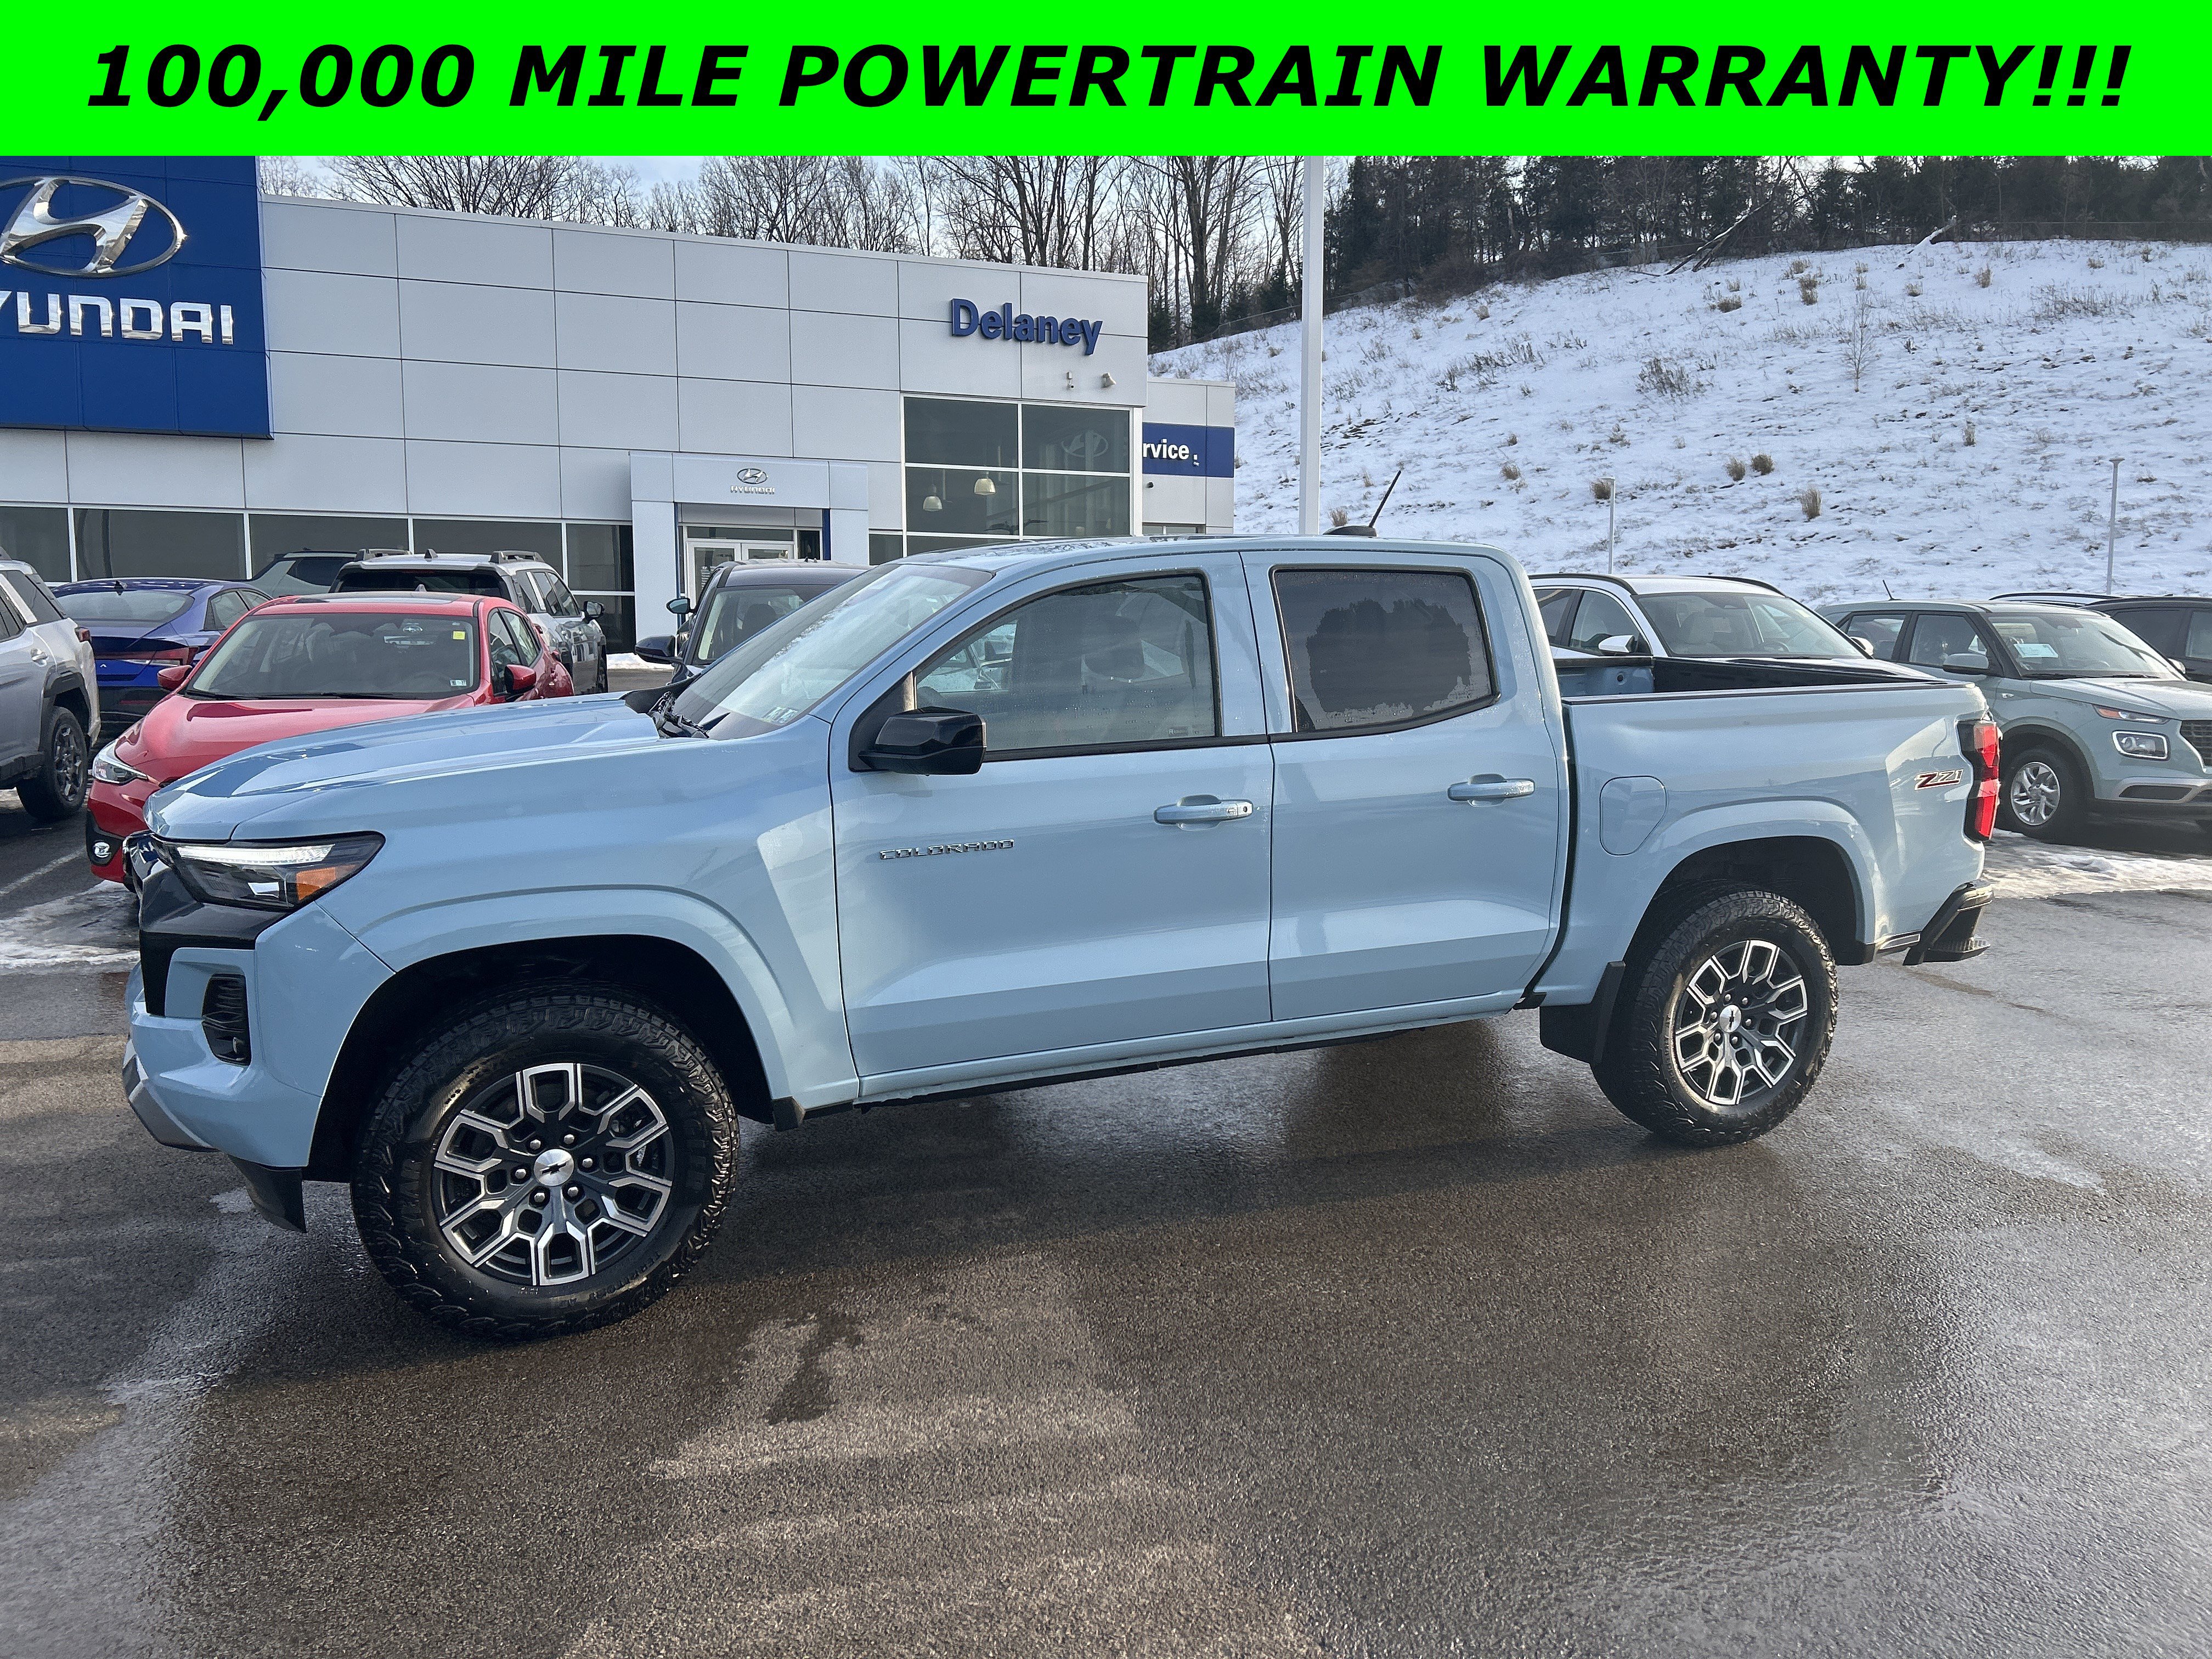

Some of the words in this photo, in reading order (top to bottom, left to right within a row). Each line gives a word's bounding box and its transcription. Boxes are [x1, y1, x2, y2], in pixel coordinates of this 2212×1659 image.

[0, 290, 234, 345] UNDAI
[951, 298, 1103, 356] Delaney
[730, 486, 775, 494] HYUNDAI
[1914, 769, 1964, 791] Z71
[880, 839, 1014, 860] COLORADO
